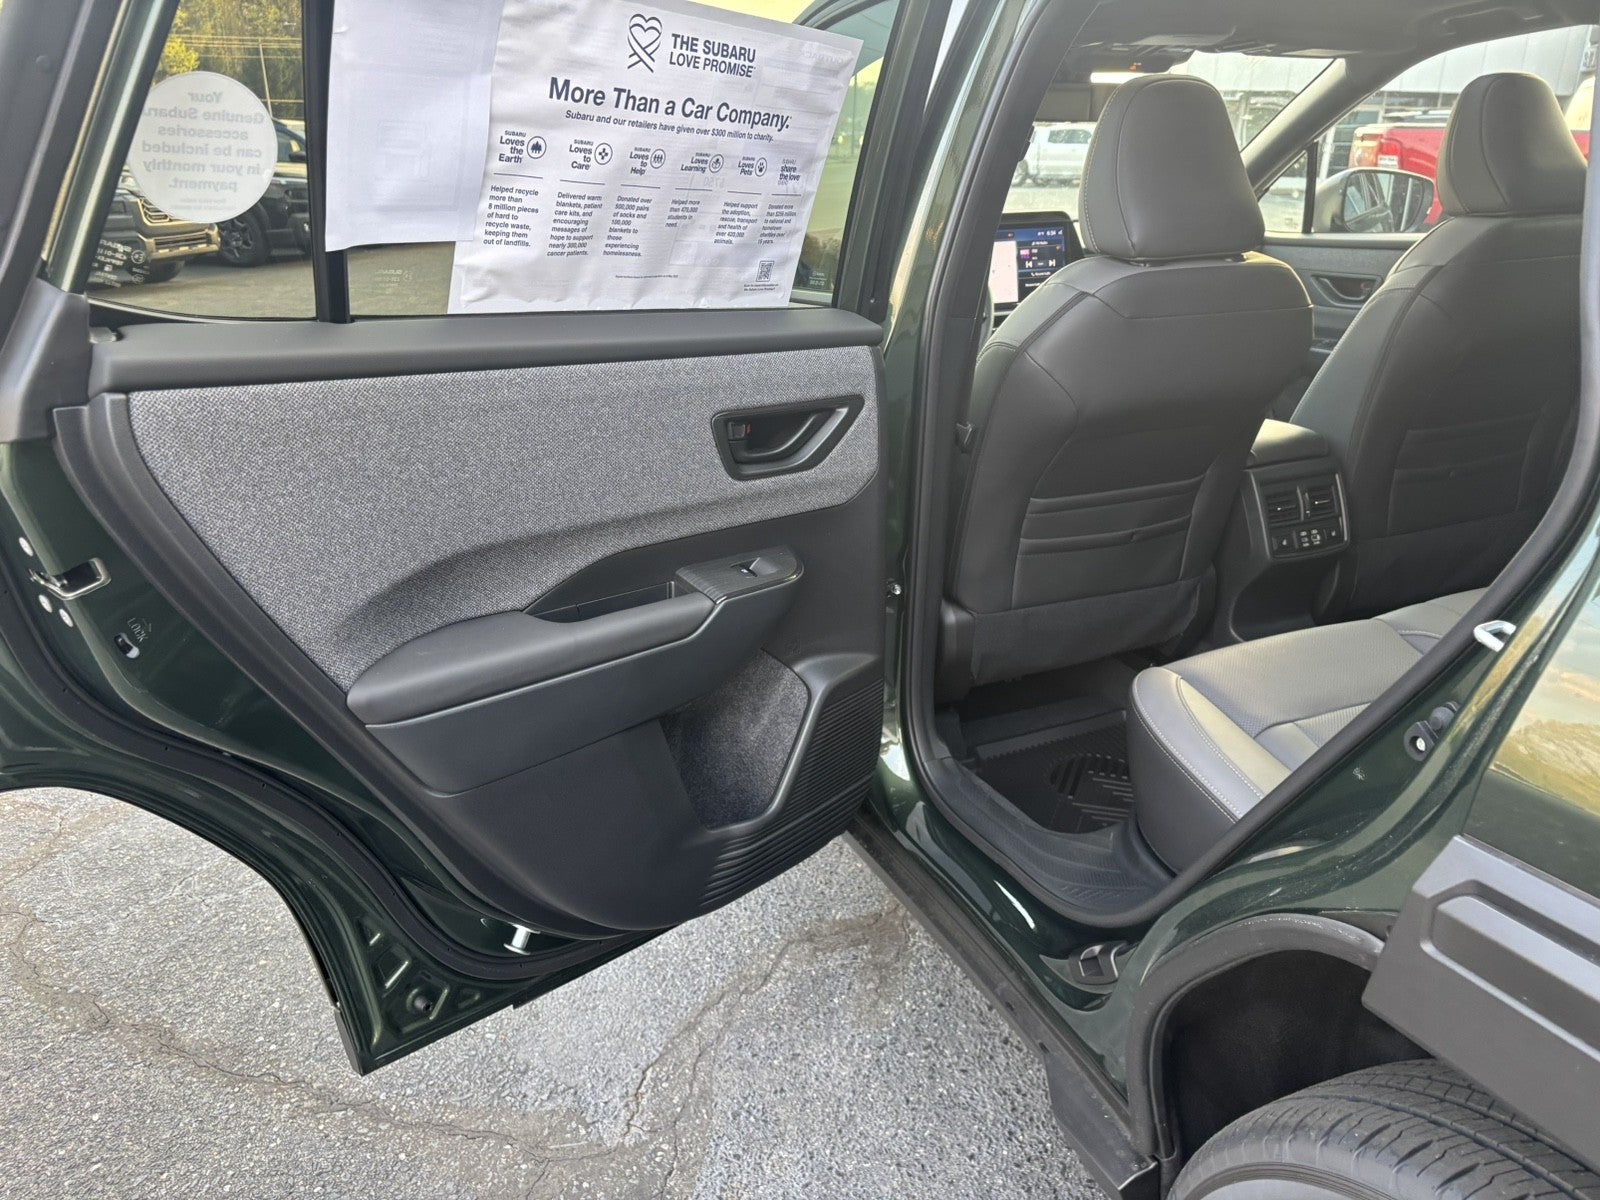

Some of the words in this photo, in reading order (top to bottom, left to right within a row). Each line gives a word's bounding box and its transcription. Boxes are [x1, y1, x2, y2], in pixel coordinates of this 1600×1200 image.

[671, 33, 699, 51] THE
[702, 40, 756, 63] SUBARU
[669, 51, 700, 70] LOVE
[702, 58, 754, 78] PROMISE
[548, 76, 606, 106] More
[613, 87, 660, 114] Than
[664, 100, 676, 116] a
[681, 97, 713, 120] Car
[716, 102, 790, 132] Company.
[565, 110, 595, 122] Subaru
[596, 115, 612, 124] and
[612, 118, 627, 126] our
[628, 120, 658, 130] retailers
[658, 122, 676, 132] have
[676, 124, 694, 135] given
[711, 128, 726, 138] $300
[726, 130, 746, 140] million
[746, 132, 753, 140] to
[754, 132, 774, 143] charity.
[500, 136, 525, 146] Loves
[510, 146, 524, 154] the
[569, 144, 593, 154] Loves
[498, 154, 522, 164] Earth
[630, 151, 649, 160] Loves
[571, 160, 590, 170] Care
[681, 164, 707, 174] Learning
[738, 161, 754, 169] Loves
[780, 164, 797, 173] share
[630, 167, 646, 176] Help
[788, 173, 800, 181] love
[490, 184, 514, 194] Helped
[514, 187, 539, 196] recycle
[558, 192, 586, 200] Delivered
[494, 204, 516, 212] million
[517, 206, 539, 214] pieces
[556, 200, 582, 209] blankets,
[510, 223, 532, 231] waste,
[484, 229, 510, 238] keeping
[511, 230, 528, 238] them
[504, 239, 531, 247] landfills.
[127, 617, 149, 644] LOCK
